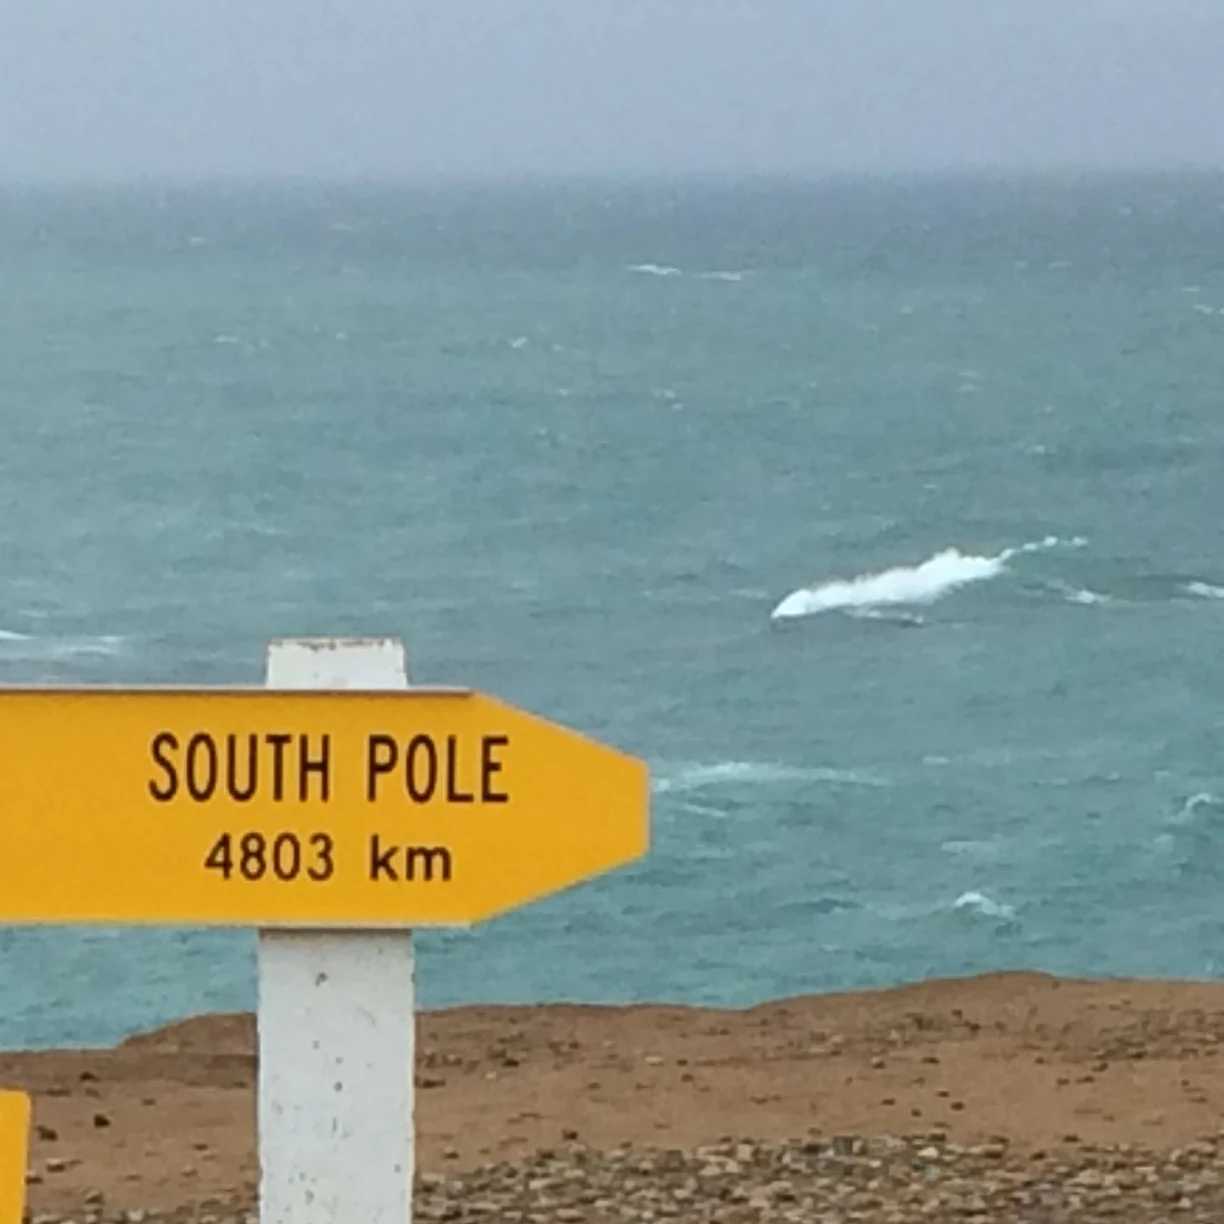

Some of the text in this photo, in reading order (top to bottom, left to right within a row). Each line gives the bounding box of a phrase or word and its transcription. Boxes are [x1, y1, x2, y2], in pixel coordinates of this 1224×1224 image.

[148, 733, 511, 804] SOUTH POLE
[203, 834, 453, 882] 4803 km
